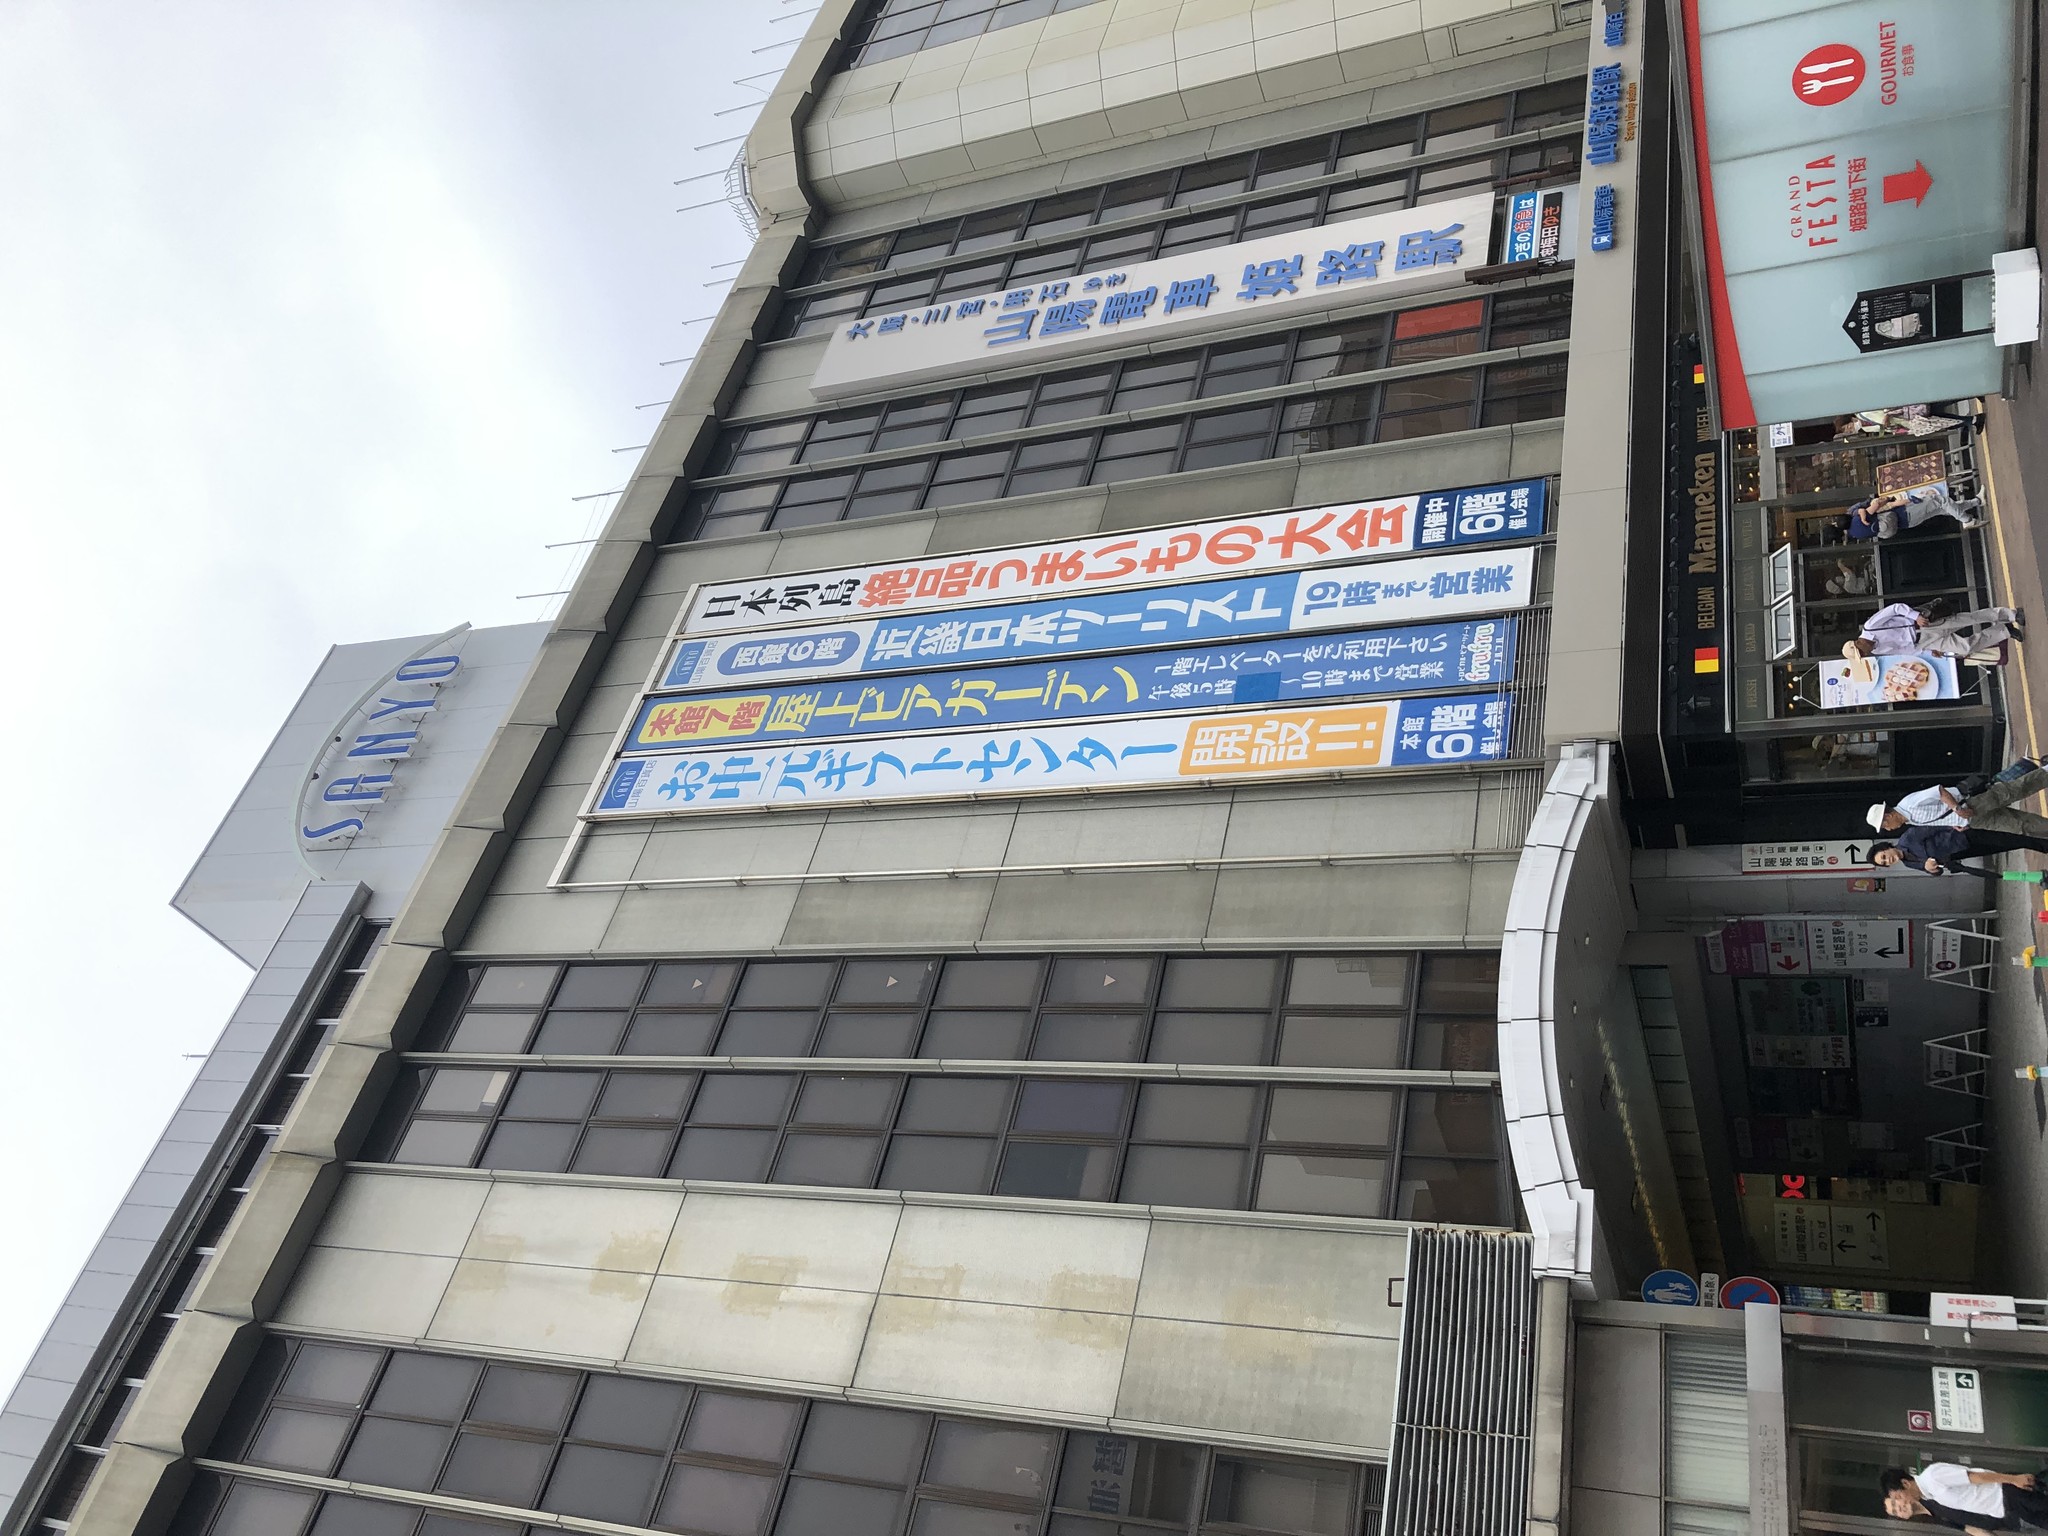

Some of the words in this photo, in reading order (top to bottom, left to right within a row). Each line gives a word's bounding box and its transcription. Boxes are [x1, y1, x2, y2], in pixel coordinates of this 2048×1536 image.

[1878, 21, 1898, 106] GOURMET
[1900, 44, 1915, 77] お食事
[1586, 62, 1621, 166] 山陽姫路駅
[1591, 183, 1614, 235] 山陽電車
[1787, 175, 1802, 238] GRAND
[1805, 154, 1838, 247] FESTA
[1847, 156, 1868, 233] 姫路地下街
[1513, 197, 1534, 261] つぎの特急は
[1421, 497, 1449, 544] 開催中
[1458, 491, 1507, 535] 6階
[1508, 487, 1530, 529] 催し会場
[1687, 451, 1718, 574] Manneken
[1302, 564, 1513, 615] 19時まで営業
[1696, 586, 1716, 629] BELGIAN
[869, 587, 1282, 661] 近畿日本ツーリスト
[1744, 623, 1756, 652] BAKED
[692, 640, 718, 684] 山陽百貨店
[730, 636, 846, 669] 西館6階
[1154, 633, 1448, 676] 1階エレベーターをご利用下さい
[1465, 623, 1495, 681] frufru
[764, 666, 1139, 733] 屋上ビアガーデン
[1746, 678, 1758, 708] FRESH
[647, 701, 765, 737] 本館7階
[1400, 717, 1425, 750] 本館
[1426, 703, 1477, 759] 6階
[302, 654, 463, 839] SANYO
[657, 735, 1179, 801] お中元ギフトセンター
[615, 770, 637, 798] SANYO
[627, 759, 657, 808] 山陽百貨店
[1748, 856, 1824, 868] 山陽姫路駅
[1764, 845, 1811, 854] 山陽電車
[1832, 927, 1847, 966] 山陽姫路駅
[1857, 933, 1869, 954] のりば
[1938, 1371, 1953, 1427] 足元段差注意
